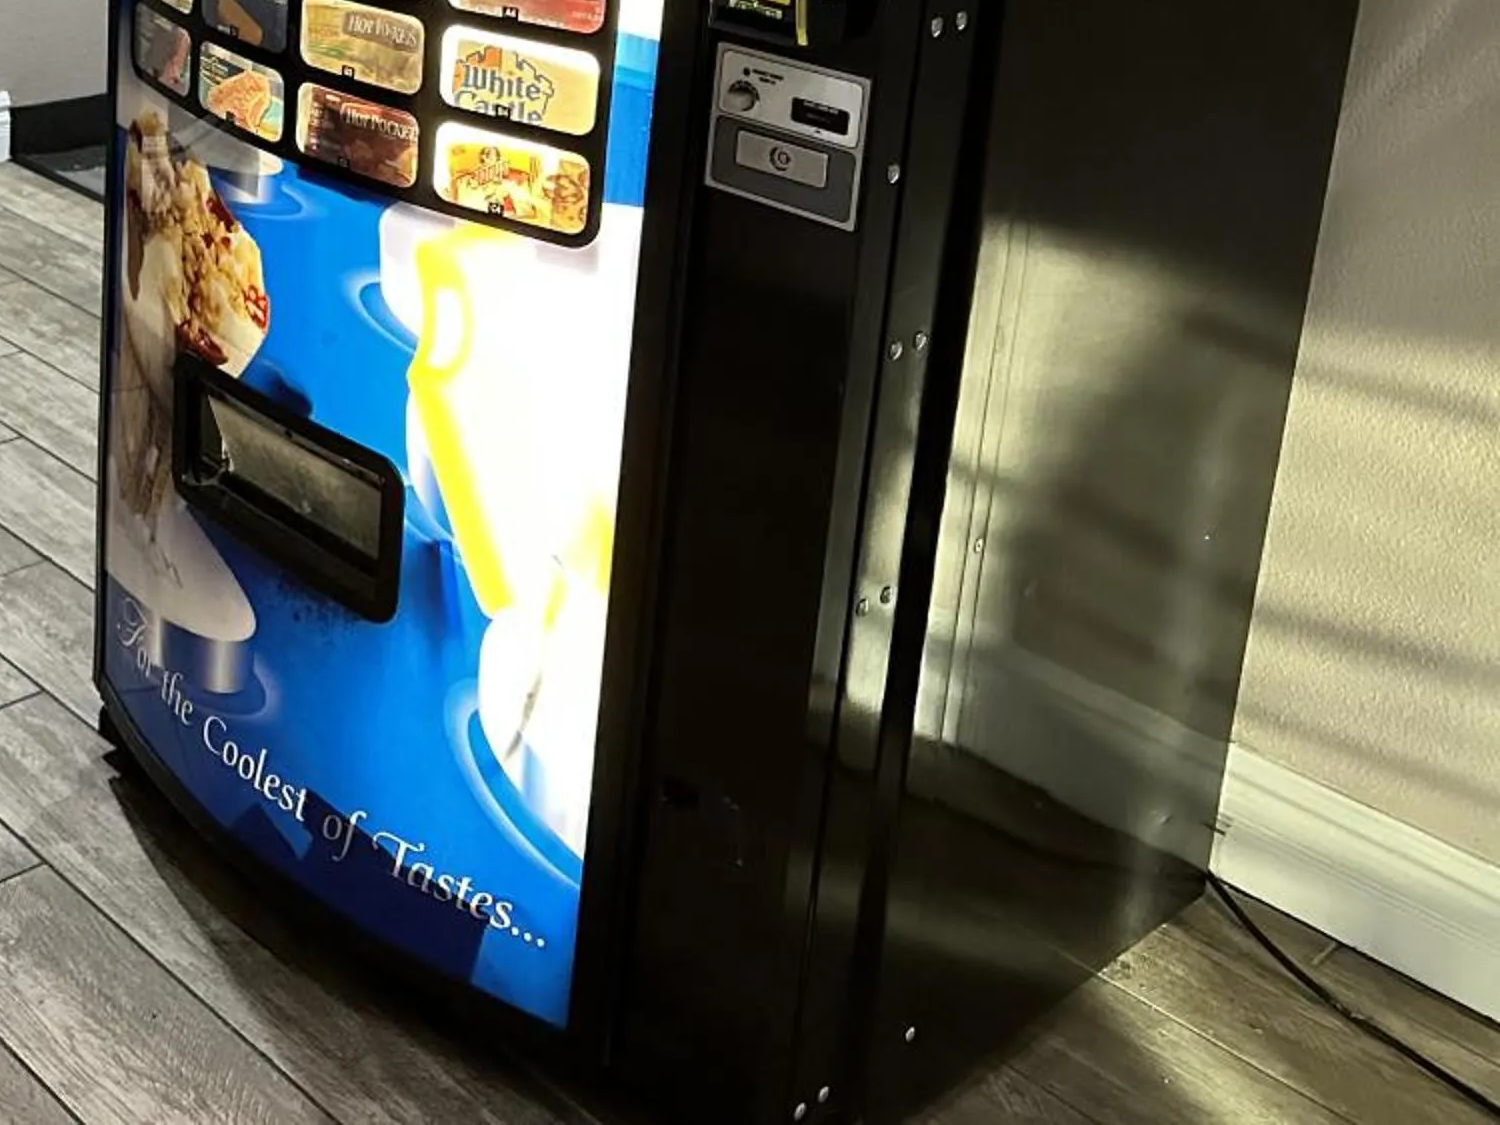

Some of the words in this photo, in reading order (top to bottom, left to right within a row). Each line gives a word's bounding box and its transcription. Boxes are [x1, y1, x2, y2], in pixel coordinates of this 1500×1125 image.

[464, 64, 542, 101] White
[116, 597, 156, 678] For
[160, 671, 195, 726] the
[203, 714, 306, 824] Coolest
[321, 810, 367, 862] of
[372, 831, 546, 949] Tastes...
